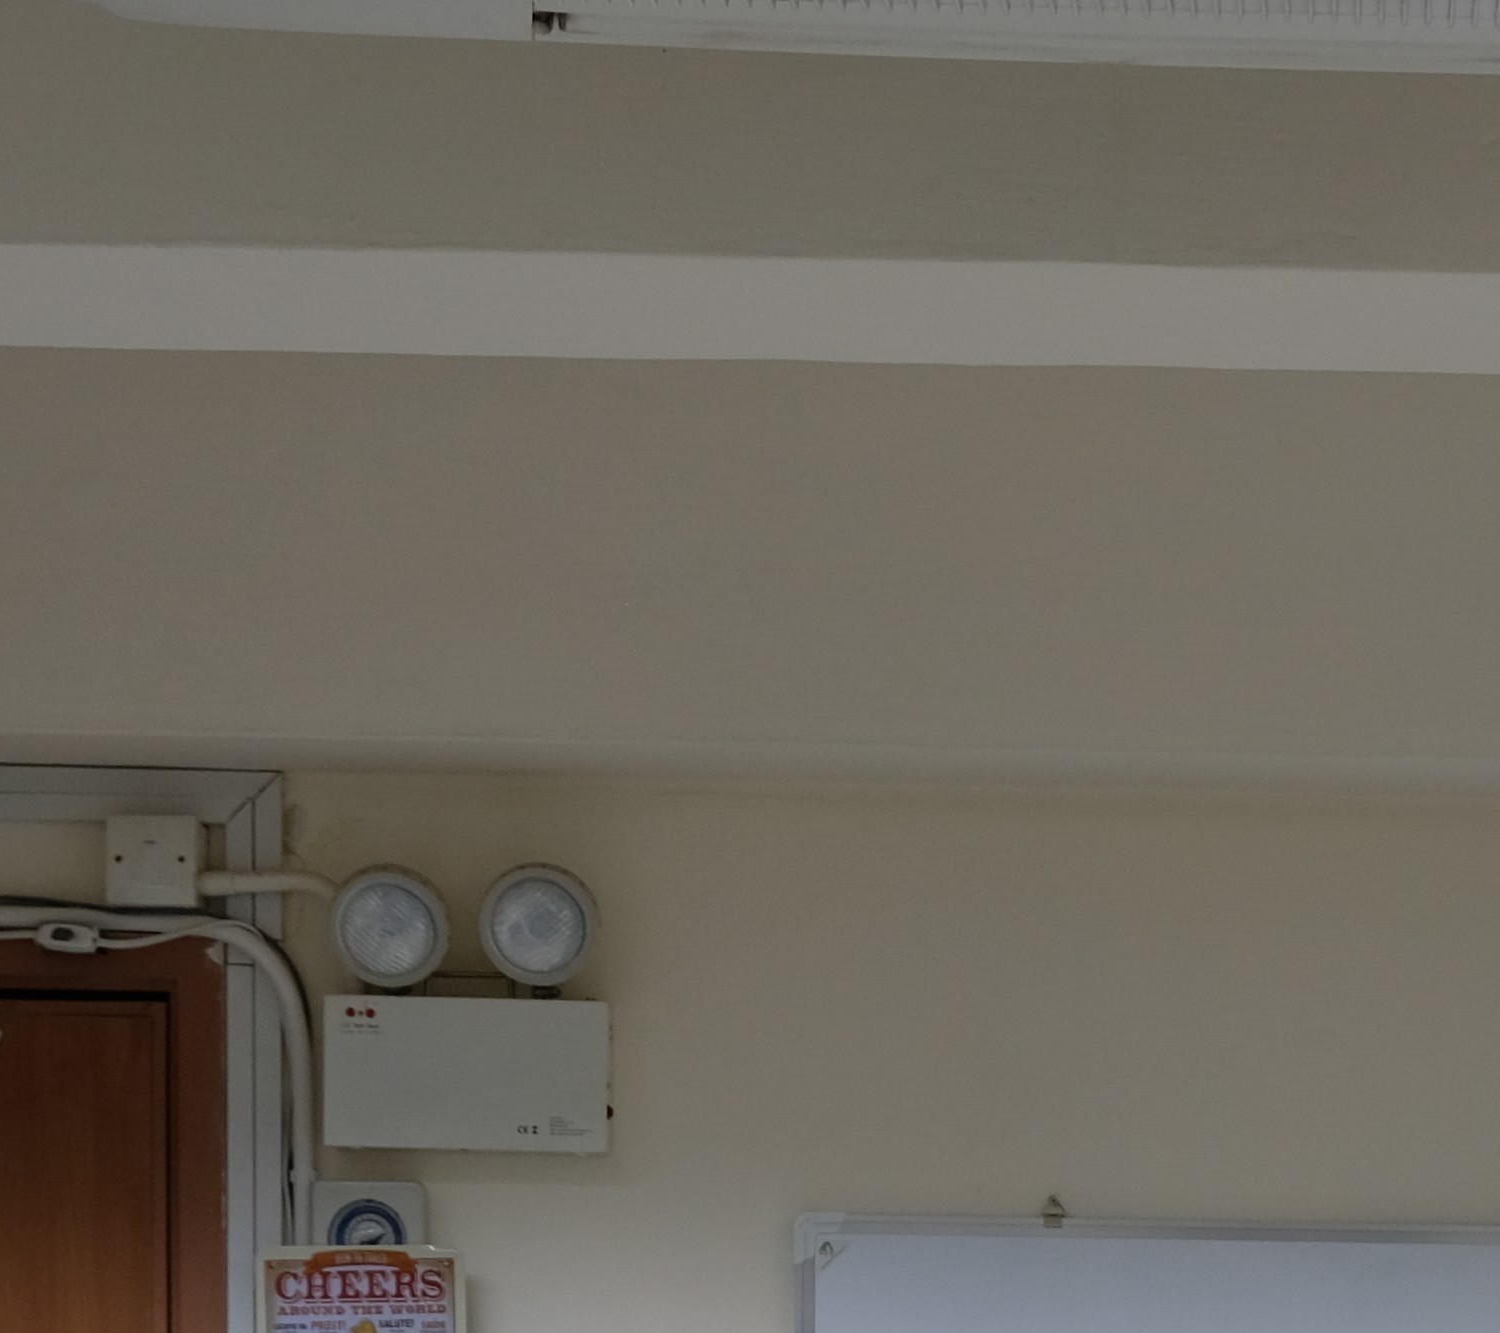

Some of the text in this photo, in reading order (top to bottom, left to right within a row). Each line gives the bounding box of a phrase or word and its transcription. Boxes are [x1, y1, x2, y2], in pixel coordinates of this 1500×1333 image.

[276, 1269, 444, 1301] CHEERS
[277, 1304, 446, 1315] AROUND THE WORLD
